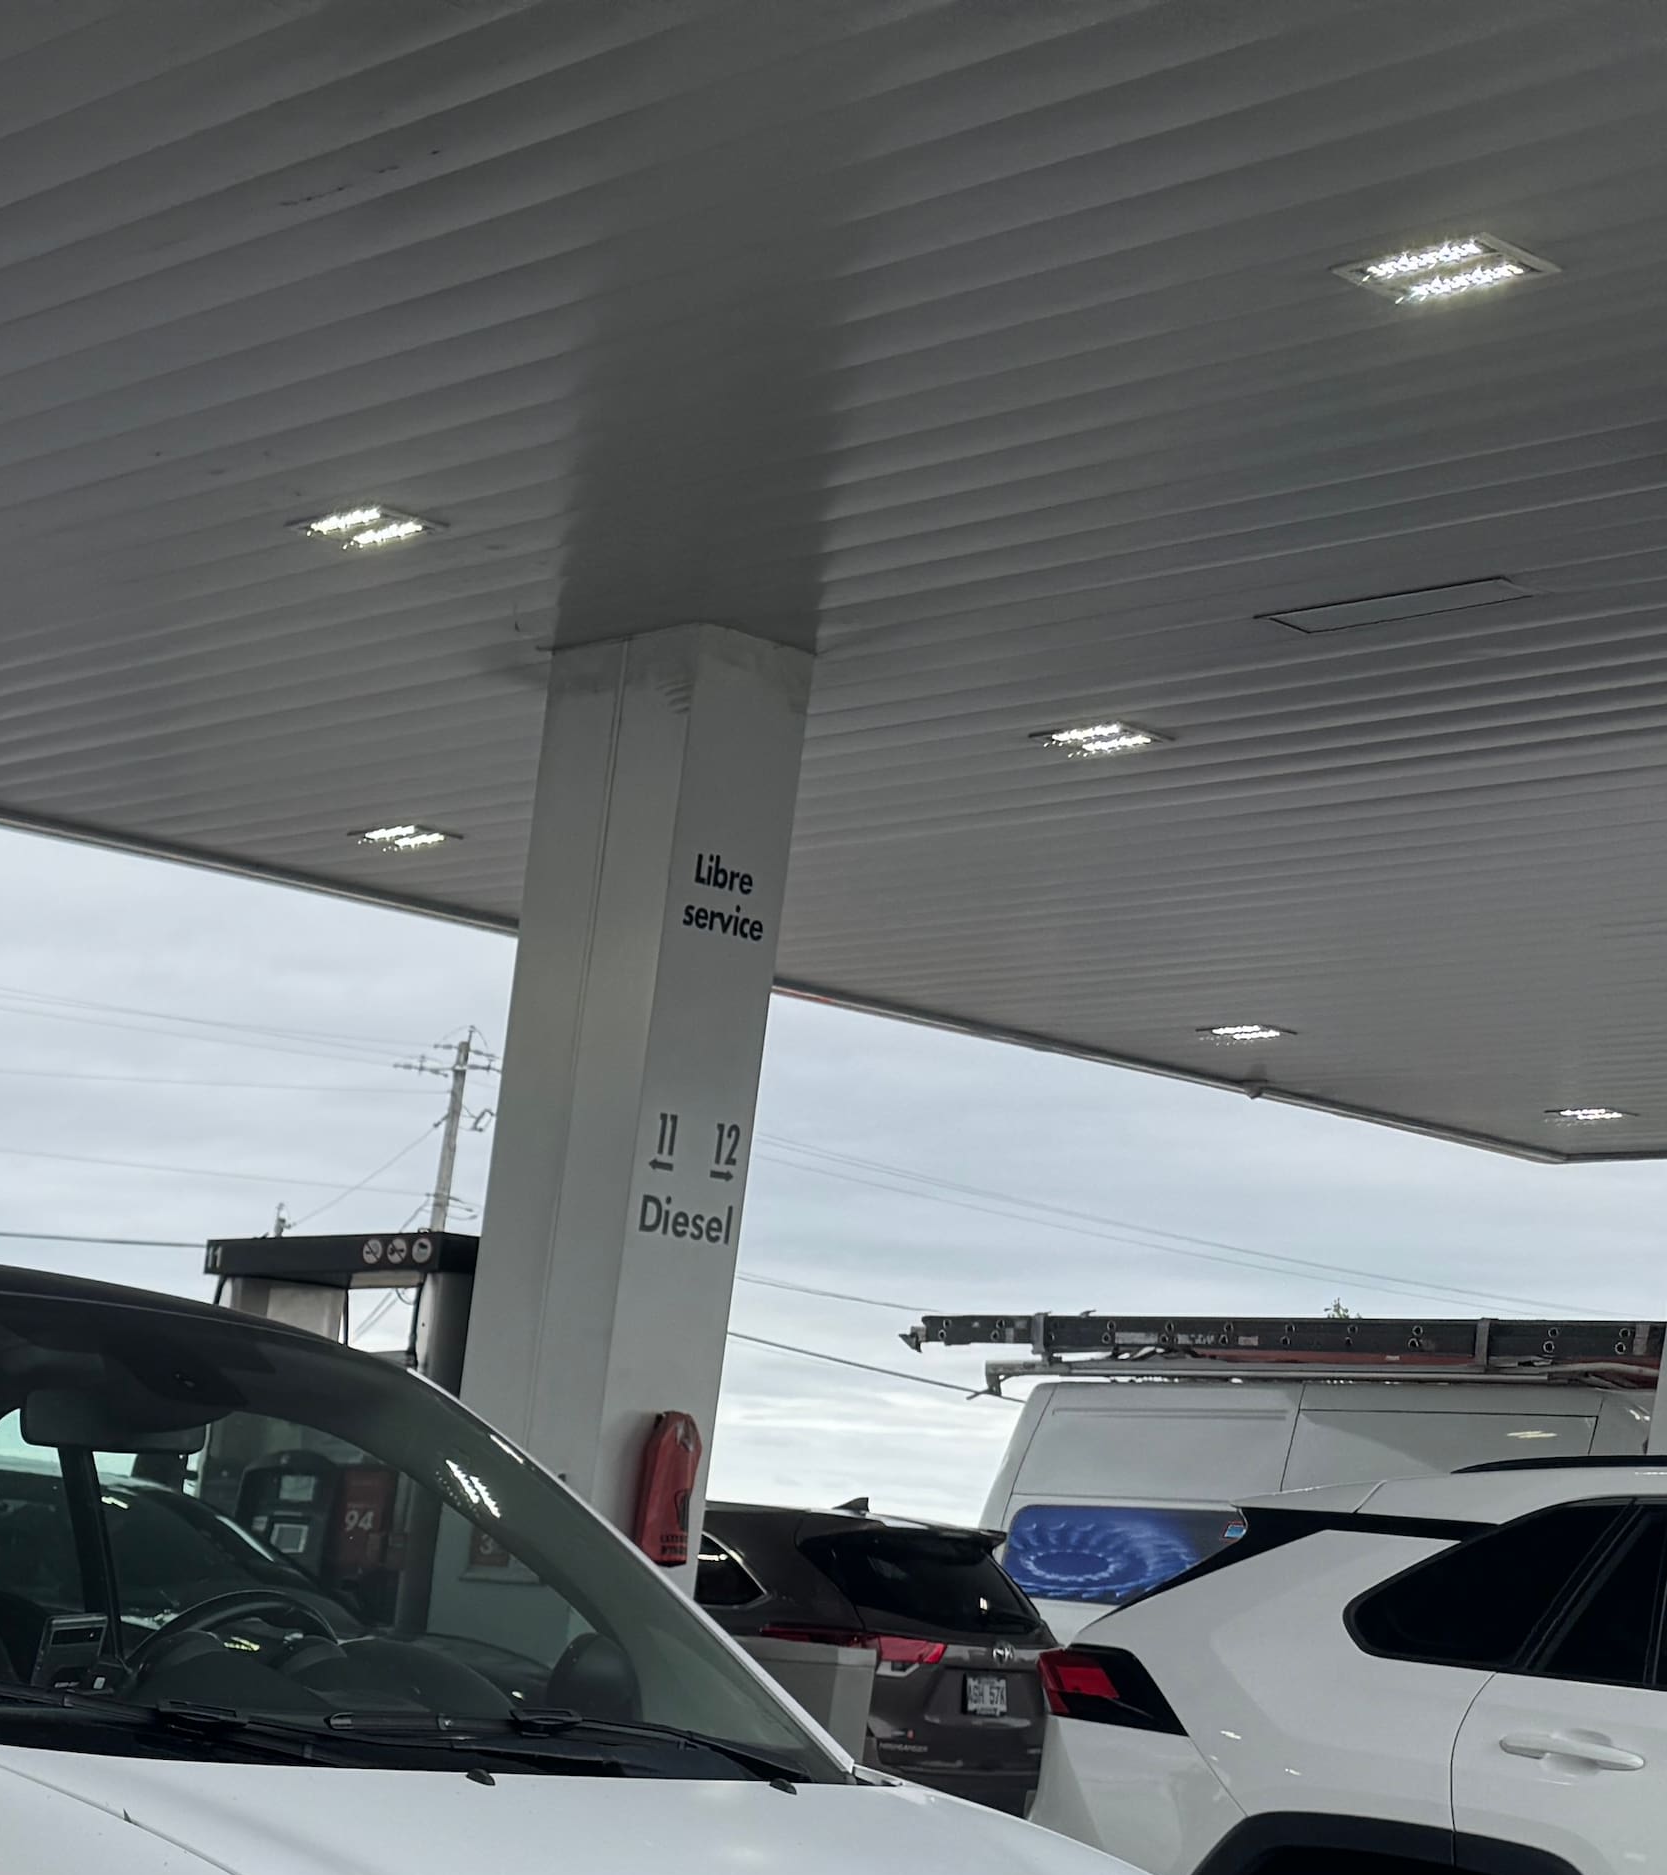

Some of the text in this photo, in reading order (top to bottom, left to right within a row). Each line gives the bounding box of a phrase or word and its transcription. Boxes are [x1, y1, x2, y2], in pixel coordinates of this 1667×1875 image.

[694, 853, 754, 895] Libre
[682, 904, 764, 942] service
[656, 1112, 741, 1167] 11 12
[638, 1194, 734, 1245] Diesel
[344, 1510, 375, 1531] 94
